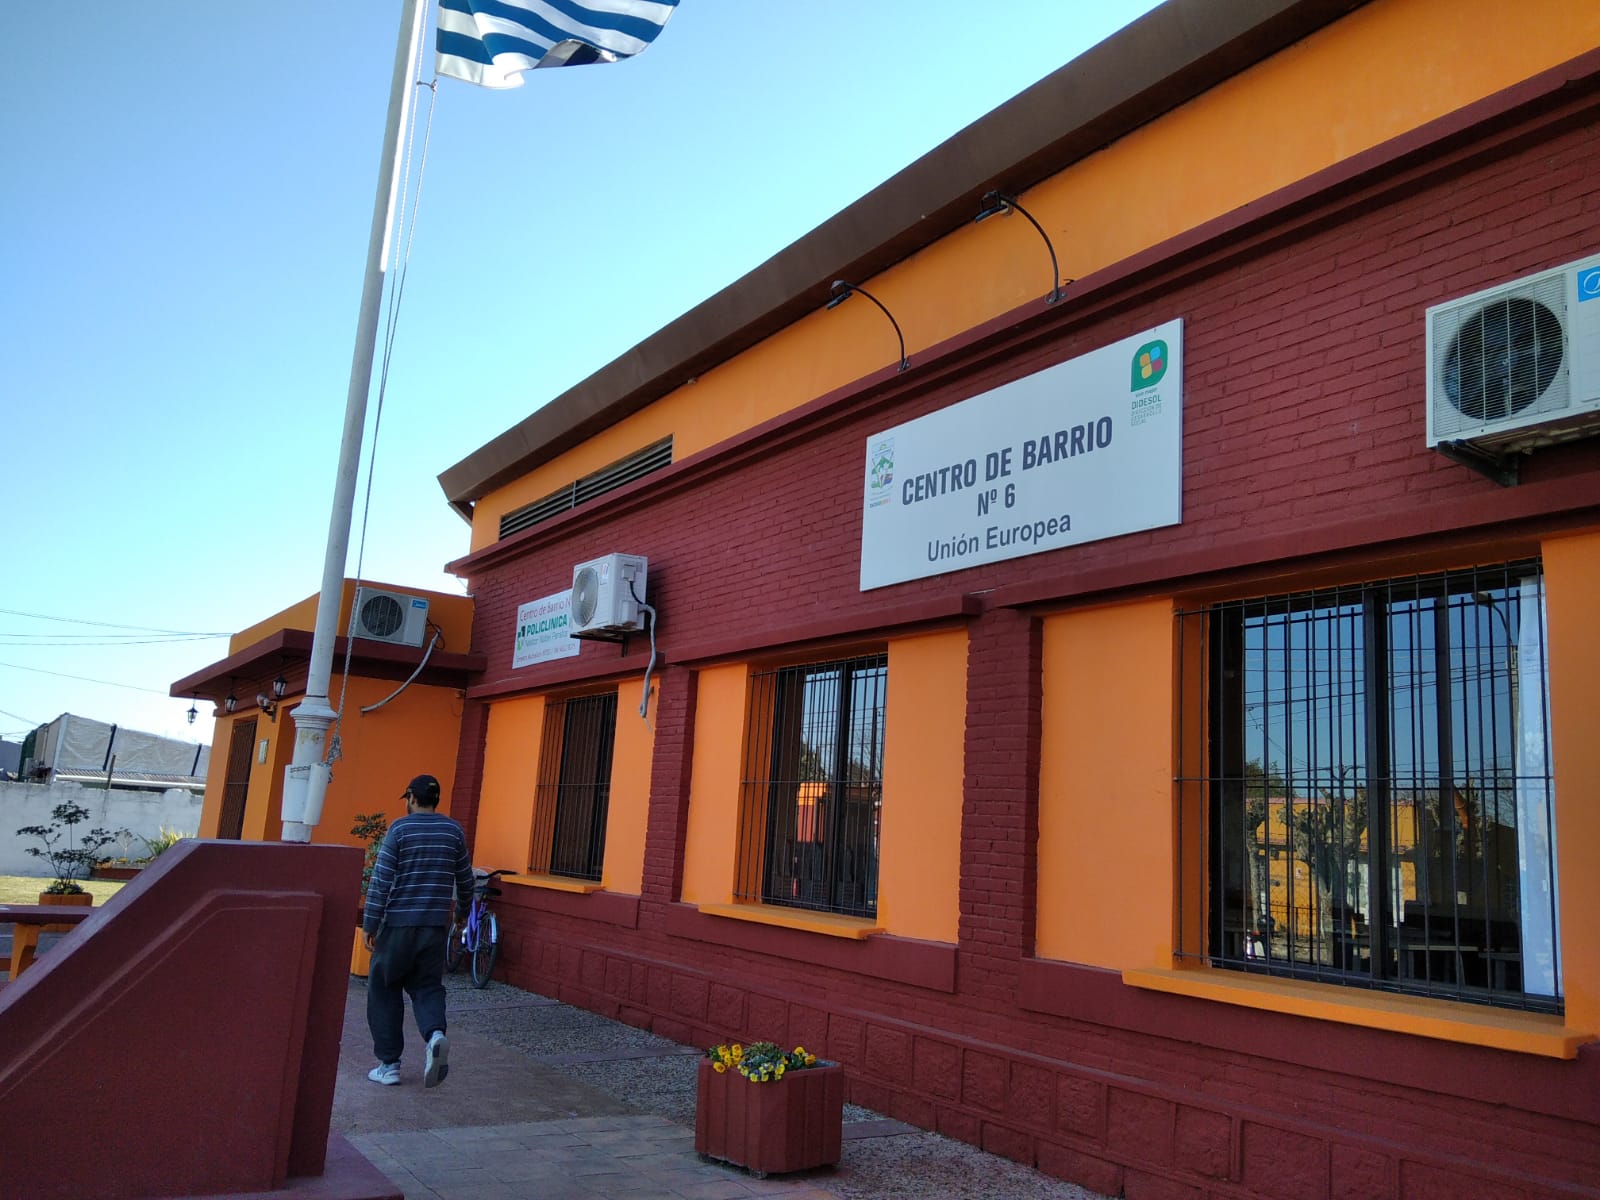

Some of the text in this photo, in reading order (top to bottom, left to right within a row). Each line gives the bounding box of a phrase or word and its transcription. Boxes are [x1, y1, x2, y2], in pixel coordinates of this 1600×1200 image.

[1131, 394, 1162, 409] DIDESOL
[902, 416, 1113, 506] CENTRO DE BARRIO
[1004, 483, 1016, 509] 6
[927, 514, 1072, 562] Unión Europea
[526, 614, 567, 637] POLICLINICA
